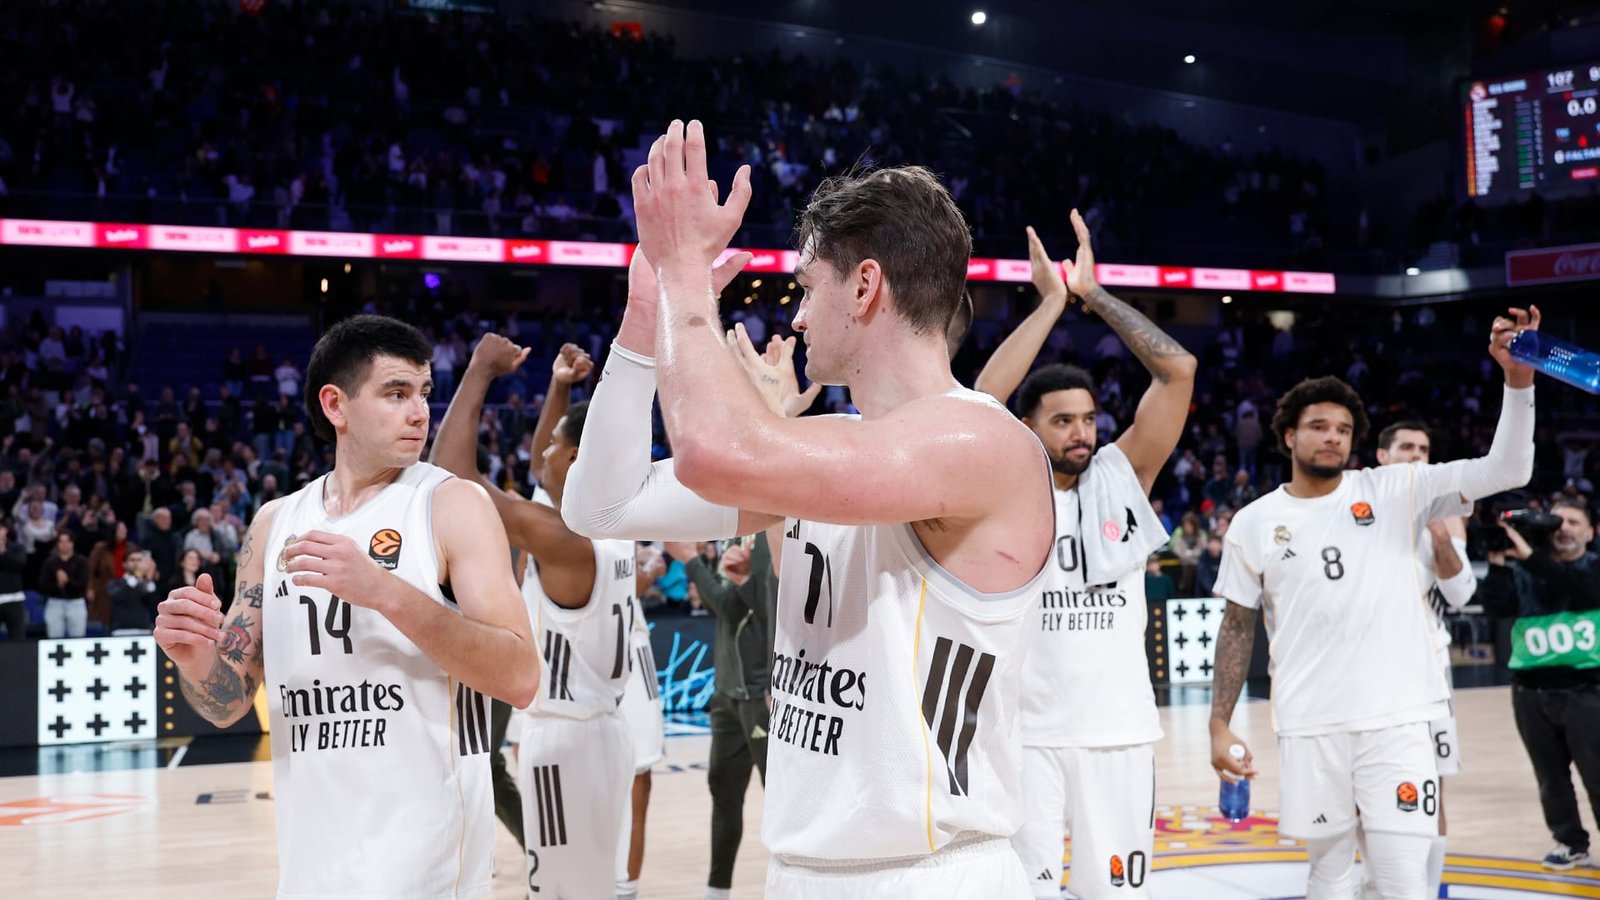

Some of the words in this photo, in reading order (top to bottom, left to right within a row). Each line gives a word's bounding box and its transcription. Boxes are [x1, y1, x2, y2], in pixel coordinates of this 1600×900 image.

[1547, 69, 1575, 88] 107
[1567, 97, 1597, 117] 0.0
[614, 557, 635, 581] MAL
[1057, 535, 1078, 572] 0
[1321, 546, 1345, 581] 8
[1041, 586, 1127, 609] mirates
[299, 594, 354, 656] 14
[1042, 613, 1063, 631] FLY
[1068, 611, 1115, 631] BETTER
[1524, 620, 1597, 657] 003
[771, 648, 867, 712] mirates
[291, 723, 310, 752] LY
[318, 718, 387, 750] BETTER
[777, 703, 844, 756] BETTER
[1434, 730, 1451, 759] 6
[1422, 779, 1437, 817] 8
[1127, 850, 1146, 888] 0
